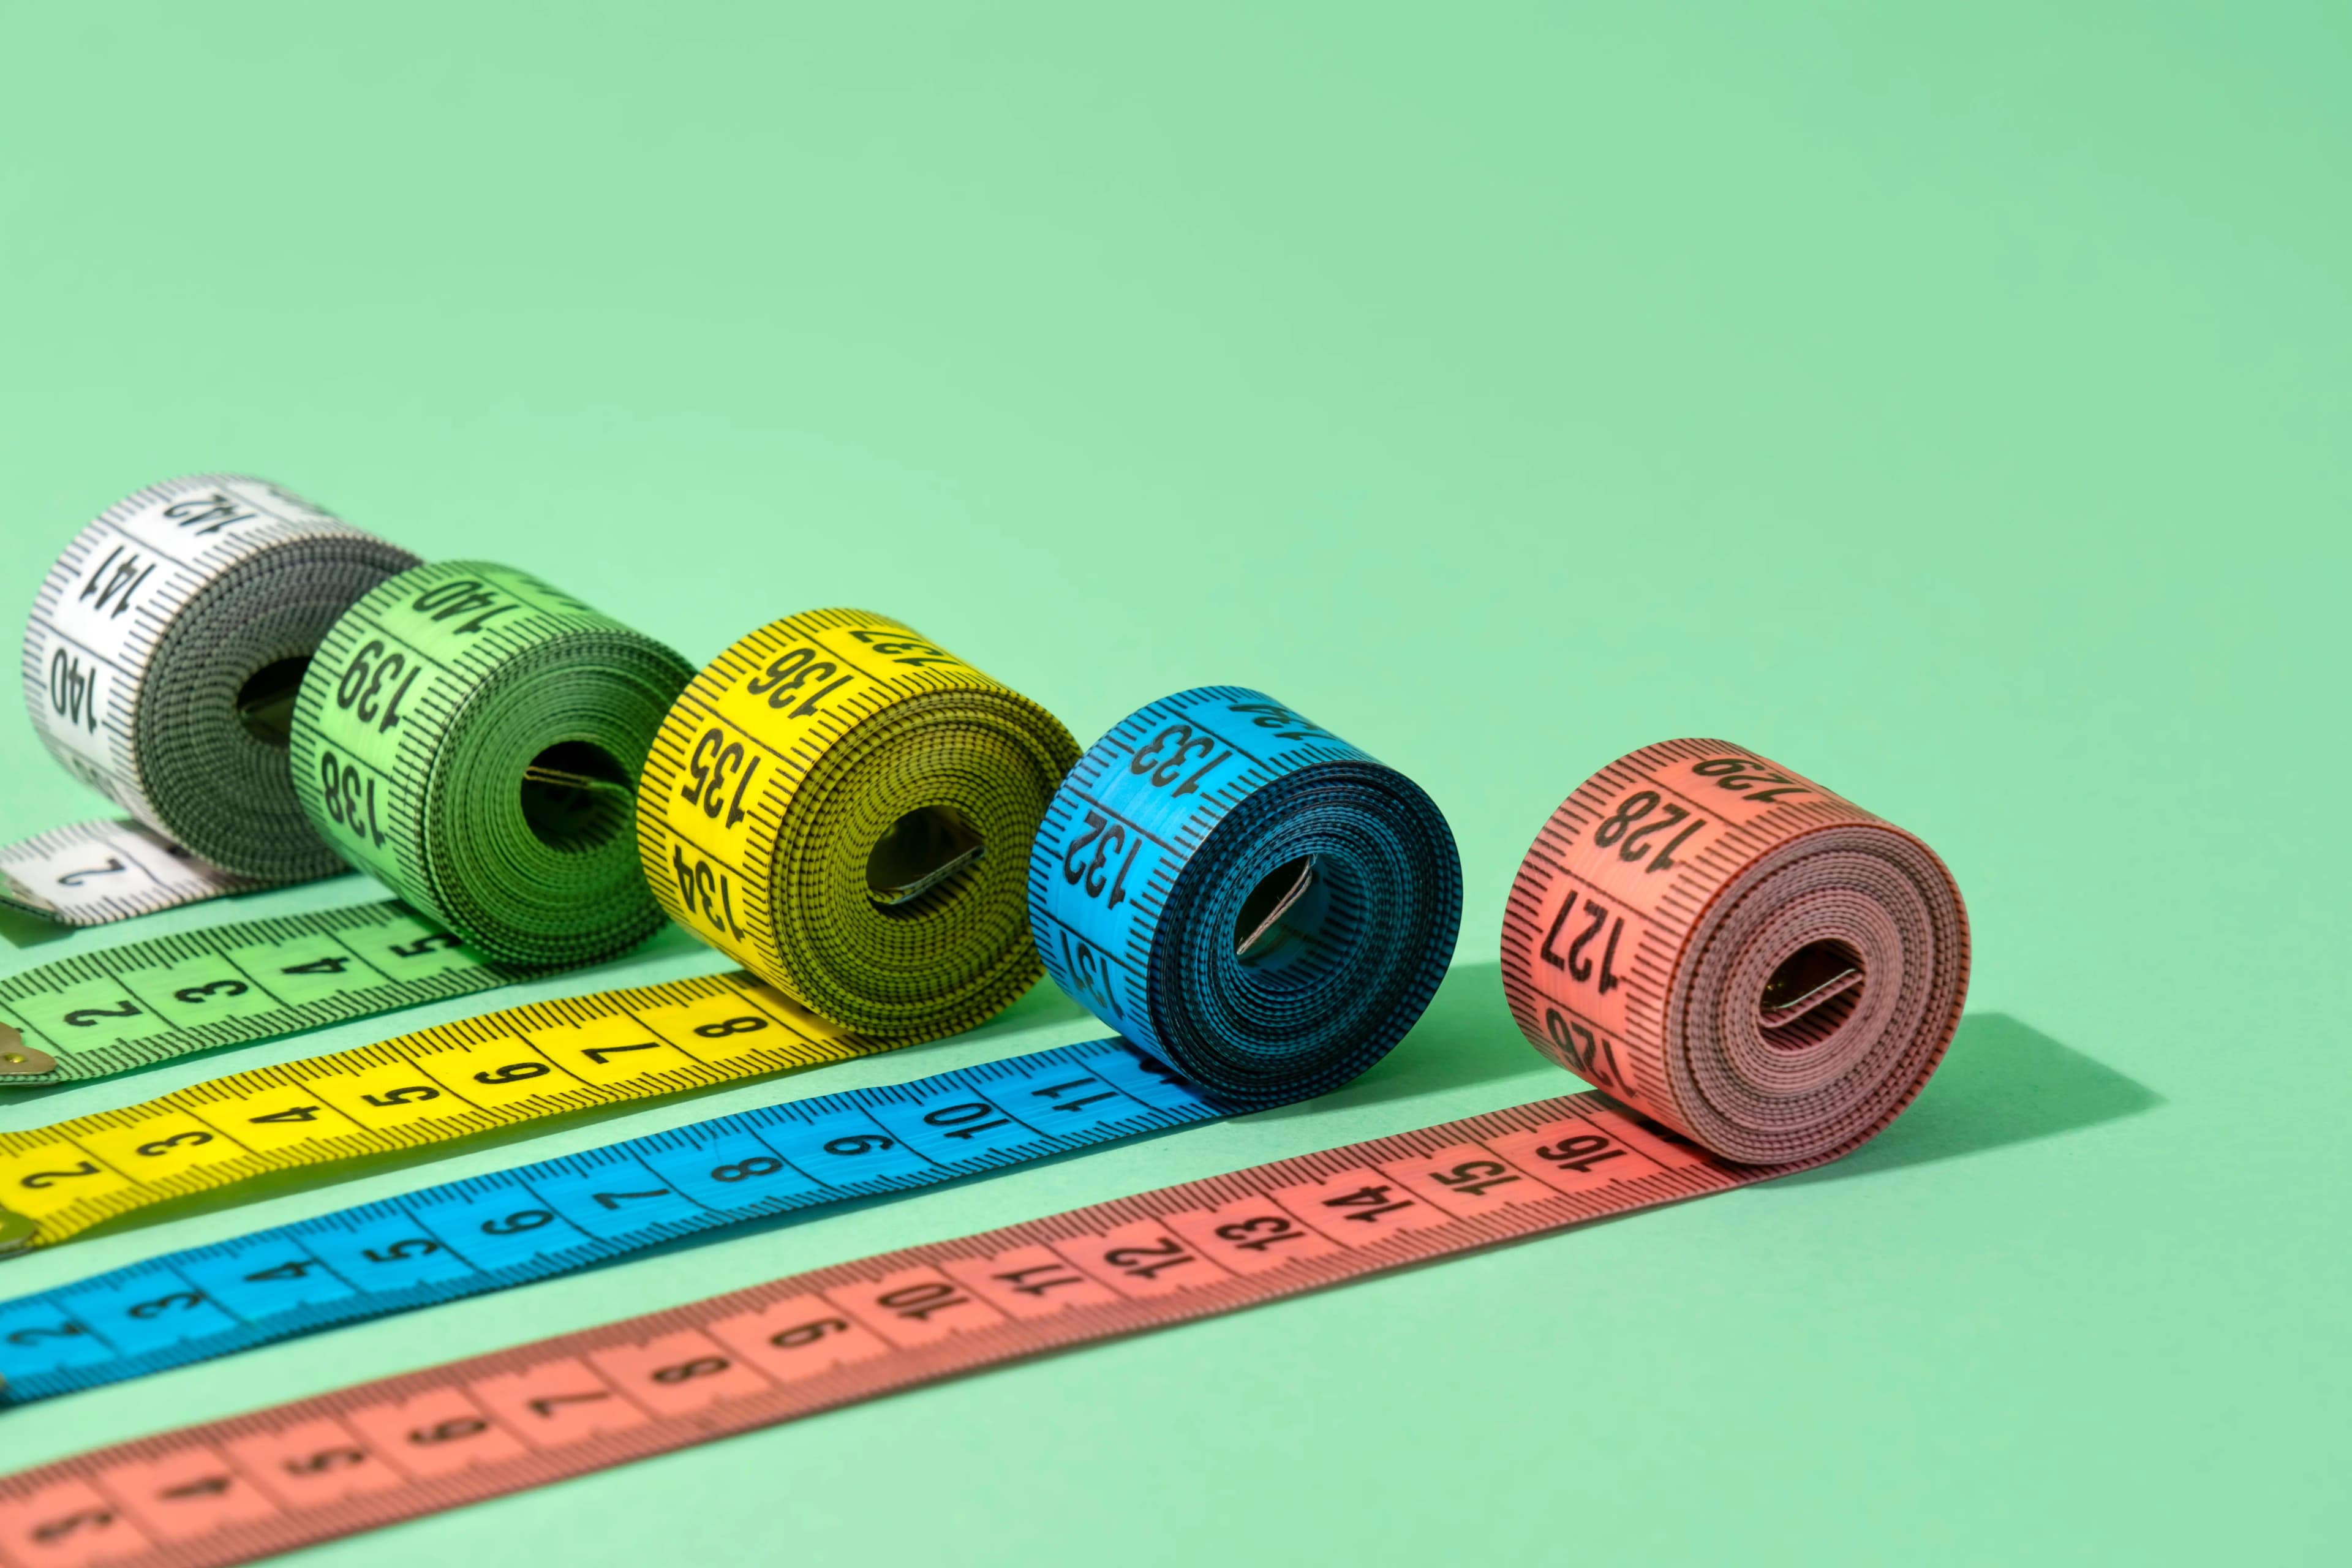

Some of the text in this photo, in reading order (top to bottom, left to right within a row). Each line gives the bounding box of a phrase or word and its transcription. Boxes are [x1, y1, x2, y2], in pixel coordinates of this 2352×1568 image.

[163, 494, 257, 535] 142
[79, 545, 157, 620] 141
[412, 580, 522, 636] 140
[848, 629, 963, 668] 137
[50, 647, 97, 735] 140
[336, 639, 421, 734] 139
[747, 646, 854, 720] 136
[1129, 723, 1232, 799] 133
[680, 728, 761, 830] 135
[1692, 758, 1812, 804] 129
[321, 750, 386, 849] 138
[1593, 790, 1707, 874] 128
[57, 856, 126, 886] 2
[1063, 809, 1142, 910] 132
[673, 844, 745, 943] 134
[391, 933, 464, 960] 5
[1540, 889, 1625, 995] 127
[281, 956, 352, 975] 4
[1060, 930, 1125, 1020] 131
[174, 979, 249, 1008] 3
[63, 999, 144, 1028] 2
[693, 1016, 769, 1038] 8
[581, 1042, 661, 1065] 7
[1545, 1006, 1638, 1099] 126
[473, 1061, 551, 1085] 6
[361, 1085, 440, 1107] 5
[1031, 1077, 1117, 1112] 11
[249, 1105, 320, 1124] 4
[924, 1102, 1011, 1139] 10
[136, 1131, 213, 1158] 3
[823, 1134, 895, 1156] 9
[1536, 1135, 1627, 1172] 16
[20, 1161, 101, 1189] 2
[710, 1156, 783, 1183] 8
[1428, 1160, 1521, 1196] 15
[592, 1188, 671, 1210] 7
[1322, 1185, 1414, 1222] 14
[480, 1209, 554, 1237] 6
[1215, 1216, 1305, 1256] 13
[362, 1238, 439, 1264] 5
[1104, 1237, 1194, 1280] 12
[243, 1259, 318, 1283] 4
[993, 1264, 1082, 1296] 11
[128, 1292, 203, 1320] 3
[876, 1283, 969, 1321] 10
[7, 1319, 84, 1346] 2
[769, 1318, 849, 1349] 9
[650, 1356, 730, 1384] 8
[526, 1390, 611, 1417] 7
[407, 1416, 488, 1444] 6
